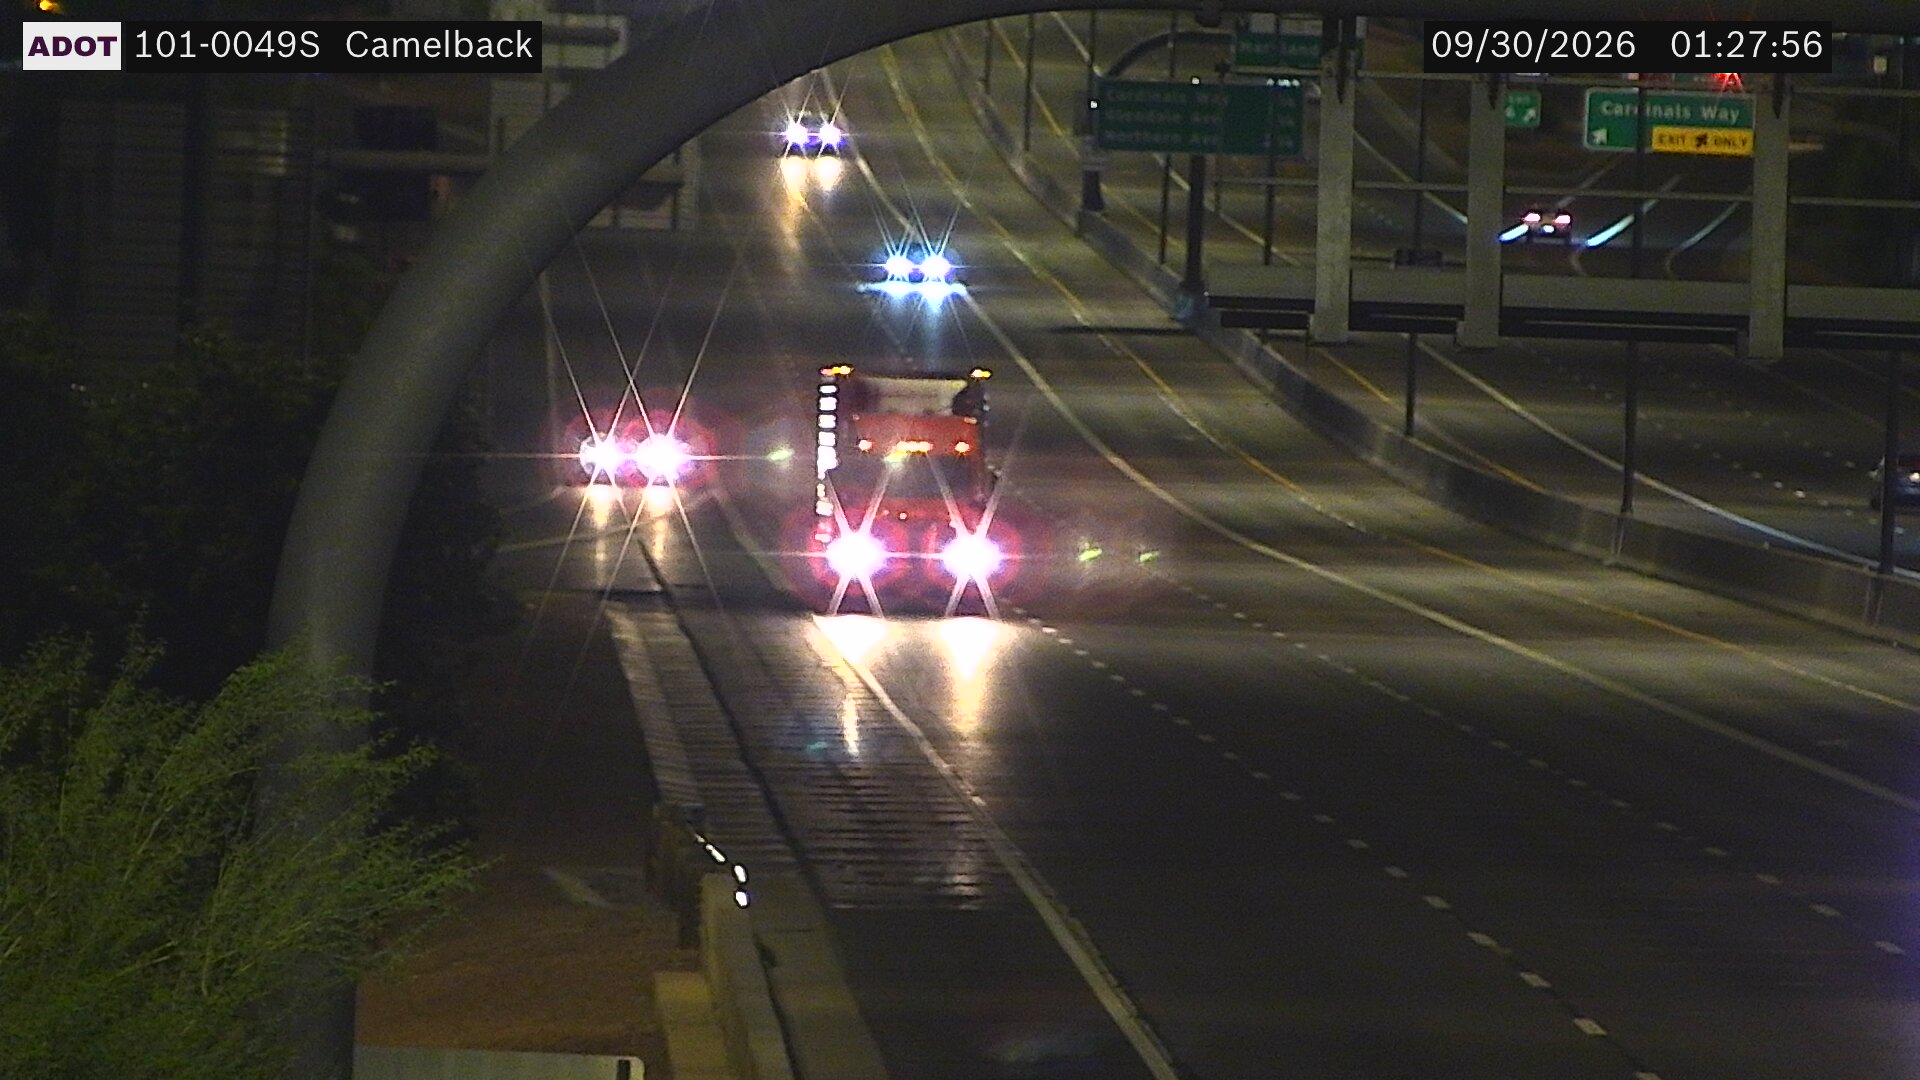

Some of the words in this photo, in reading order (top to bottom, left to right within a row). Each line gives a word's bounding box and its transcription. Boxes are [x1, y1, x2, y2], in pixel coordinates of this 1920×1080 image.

[1701, 105, 1740, 125] Way
[1658, 133, 1687, 147] EXIT
[1714, 135, 1748, 148] ONLY
